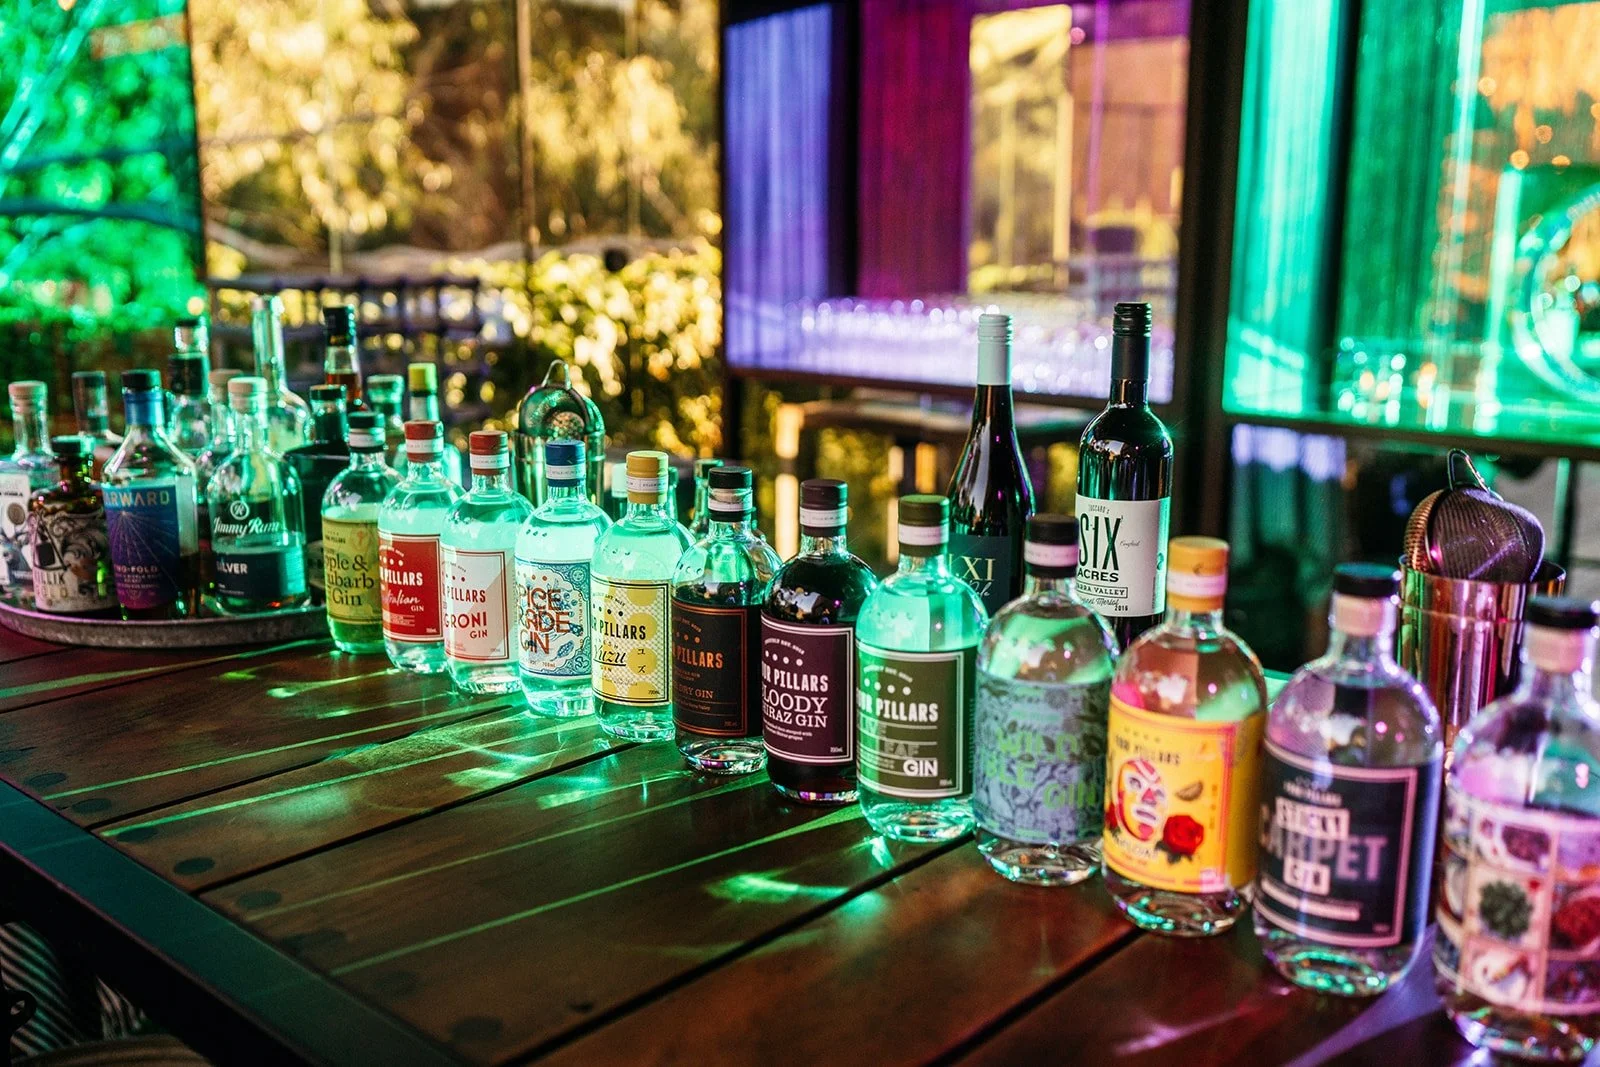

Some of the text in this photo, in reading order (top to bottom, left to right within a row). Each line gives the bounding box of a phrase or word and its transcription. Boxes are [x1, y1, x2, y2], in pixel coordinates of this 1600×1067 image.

[102, 490, 170, 508] ARWARD
[248, 516, 280, 534] Rum
[1078, 513, 1122, 571] SIX
[352, 554, 369, 573] &
[327, 571, 375, 590] ubarb
[384, 567, 424, 587] PILLARS
[1077, 568, 1120, 583] ACRES
[331, 587, 363, 607] Gin
[517, 583, 562, 611] PICE
[1093, 587, 1125, 596] VALLEY
[410, 605, 425, 613] GIN
[443, 611, 487, 629] GRONI
[469, 629, 488, 639] GIN
[599, 619, 647, 641] PILLARS
[676, 645, 724, 669] PILLARS
[773, 667, 829, 693] PILLARS
[695, 688, 714, 699] GIN
[762, 682, 828, 714] LOODY
[856, 688, 939, 723] UR PILLARS
[762, 702, 793, 725] HIRAZ
[795, 713, 828, 729] GIN
[902, 759, 939, 778] GIN
